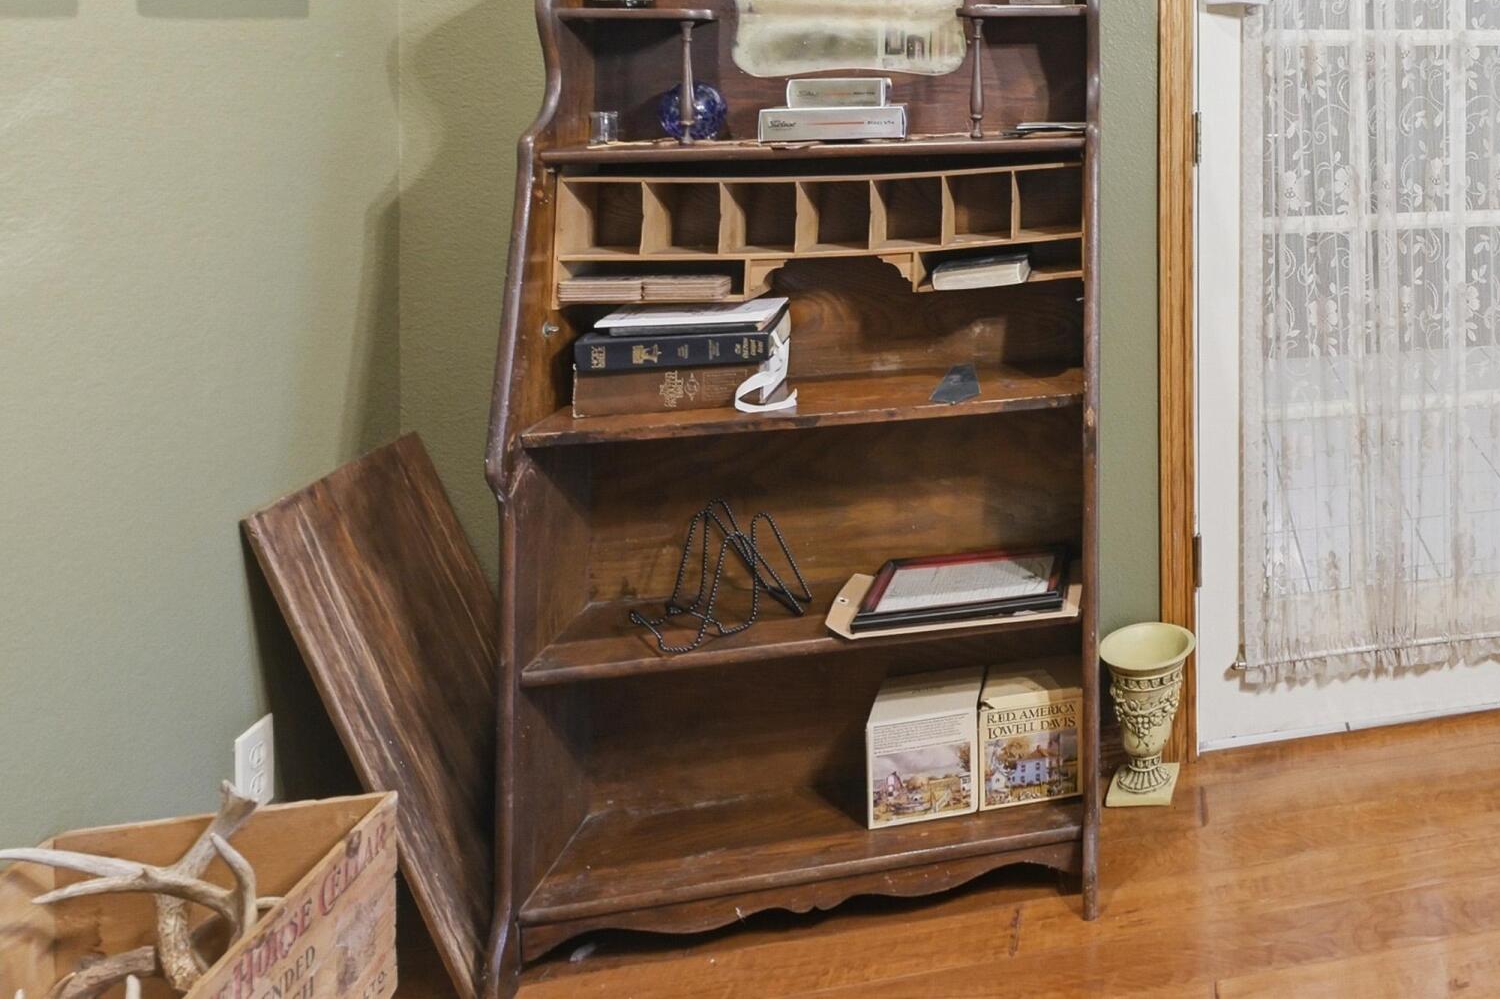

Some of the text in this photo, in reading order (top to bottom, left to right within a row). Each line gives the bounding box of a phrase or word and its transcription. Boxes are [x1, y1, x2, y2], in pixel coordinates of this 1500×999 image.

[1018, 703, 1075, 719] AMERICA
[988, 716, 1077, 741] LOWELL DAVIS
